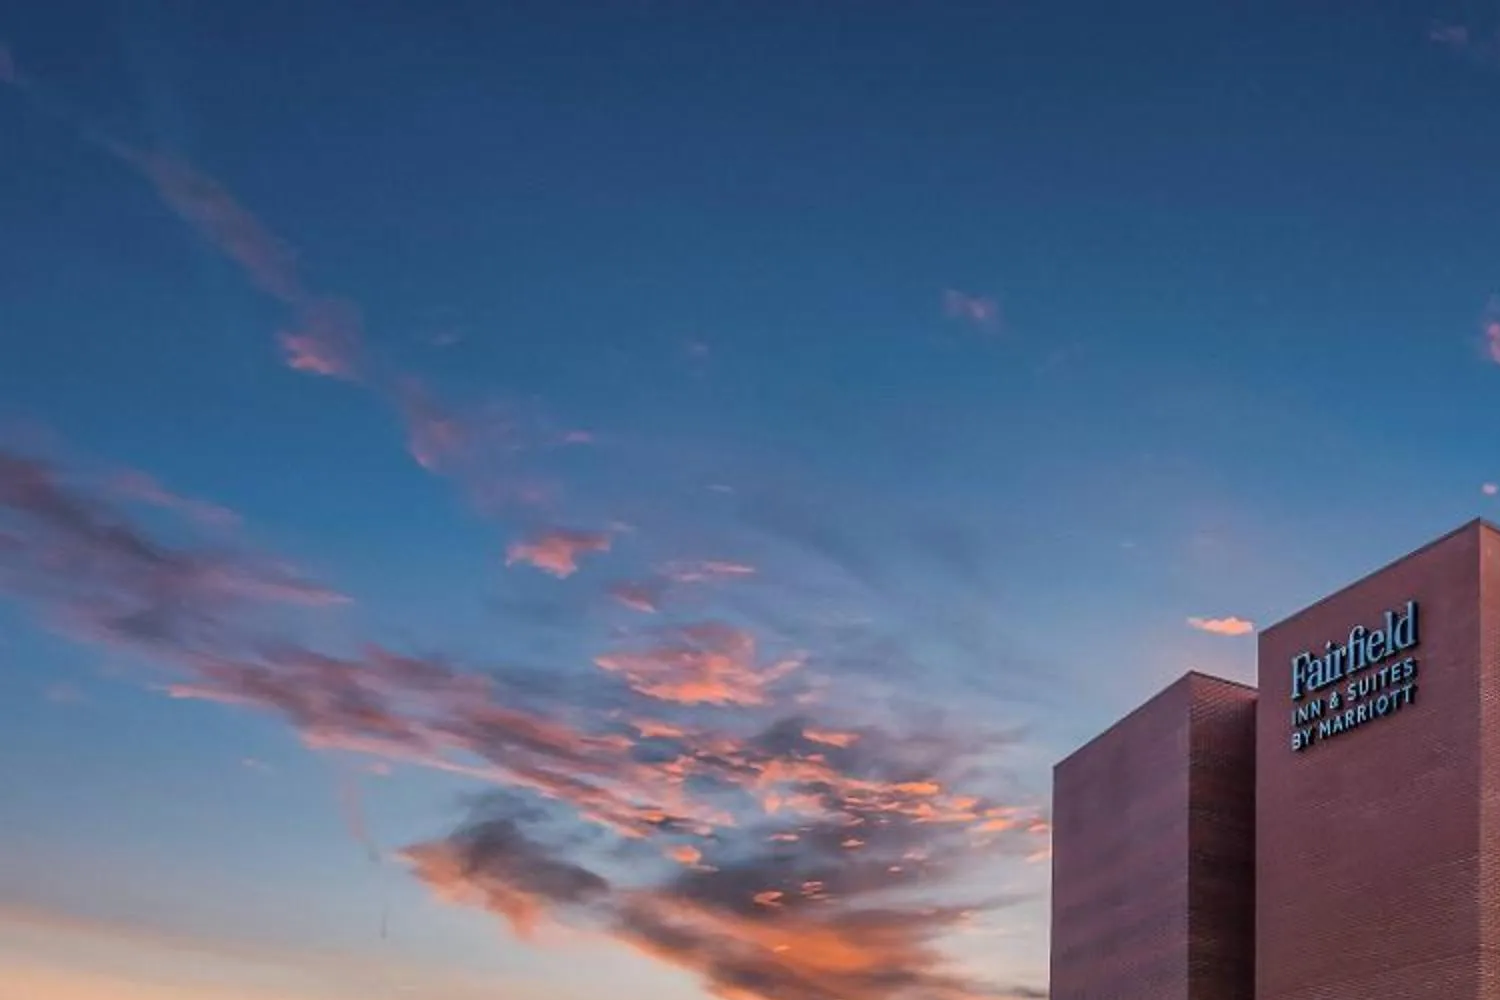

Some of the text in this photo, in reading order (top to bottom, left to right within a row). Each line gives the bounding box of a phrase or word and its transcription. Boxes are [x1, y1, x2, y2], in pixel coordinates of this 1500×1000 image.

[1291, 601, 1418, 699] Fairfield
[1291, 656, 1416, 727] INN & SUITES
[1291, 684, 1416, 752] BY MARRIOTT
